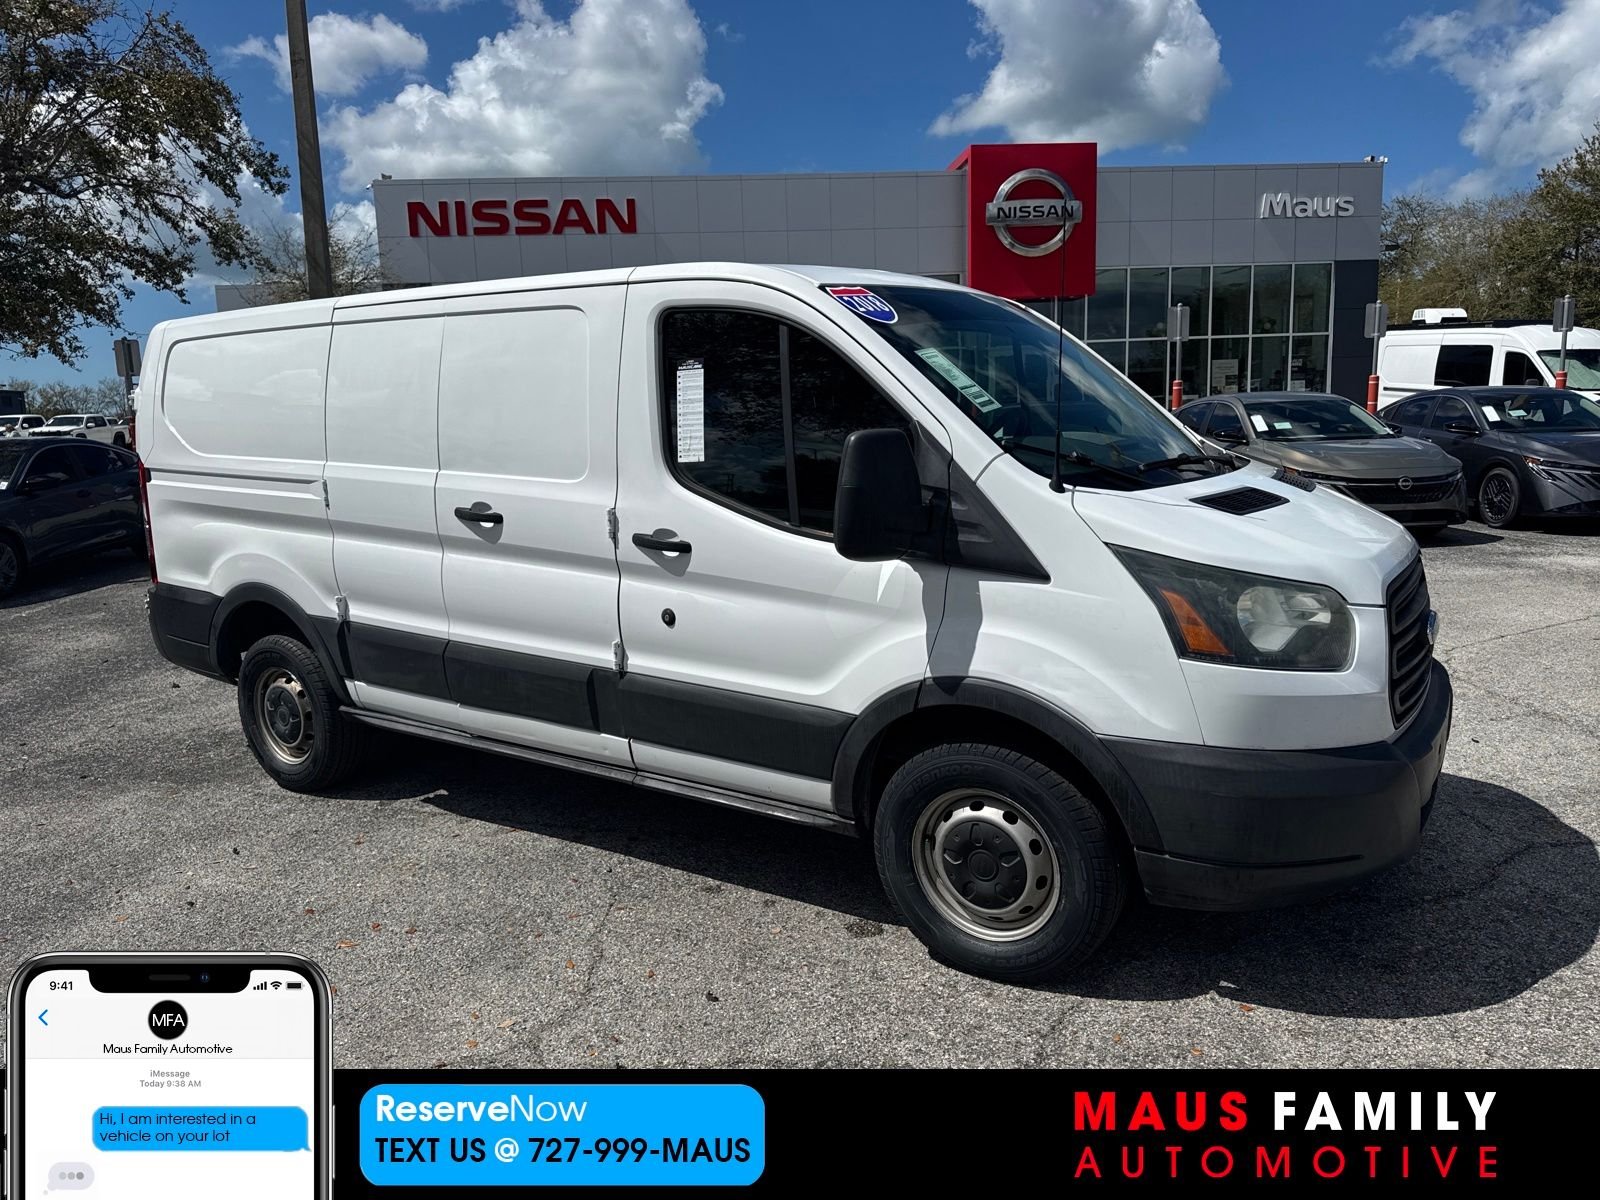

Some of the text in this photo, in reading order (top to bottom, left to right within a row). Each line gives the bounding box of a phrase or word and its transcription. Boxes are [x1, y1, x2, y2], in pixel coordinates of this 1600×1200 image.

[996, 204, 1074, 219] NISSAN
[1260, 192, 1355, 219] Maus
[407, 198, 637, 237] NISSAN
[842, 295, 890, 312] 2018
